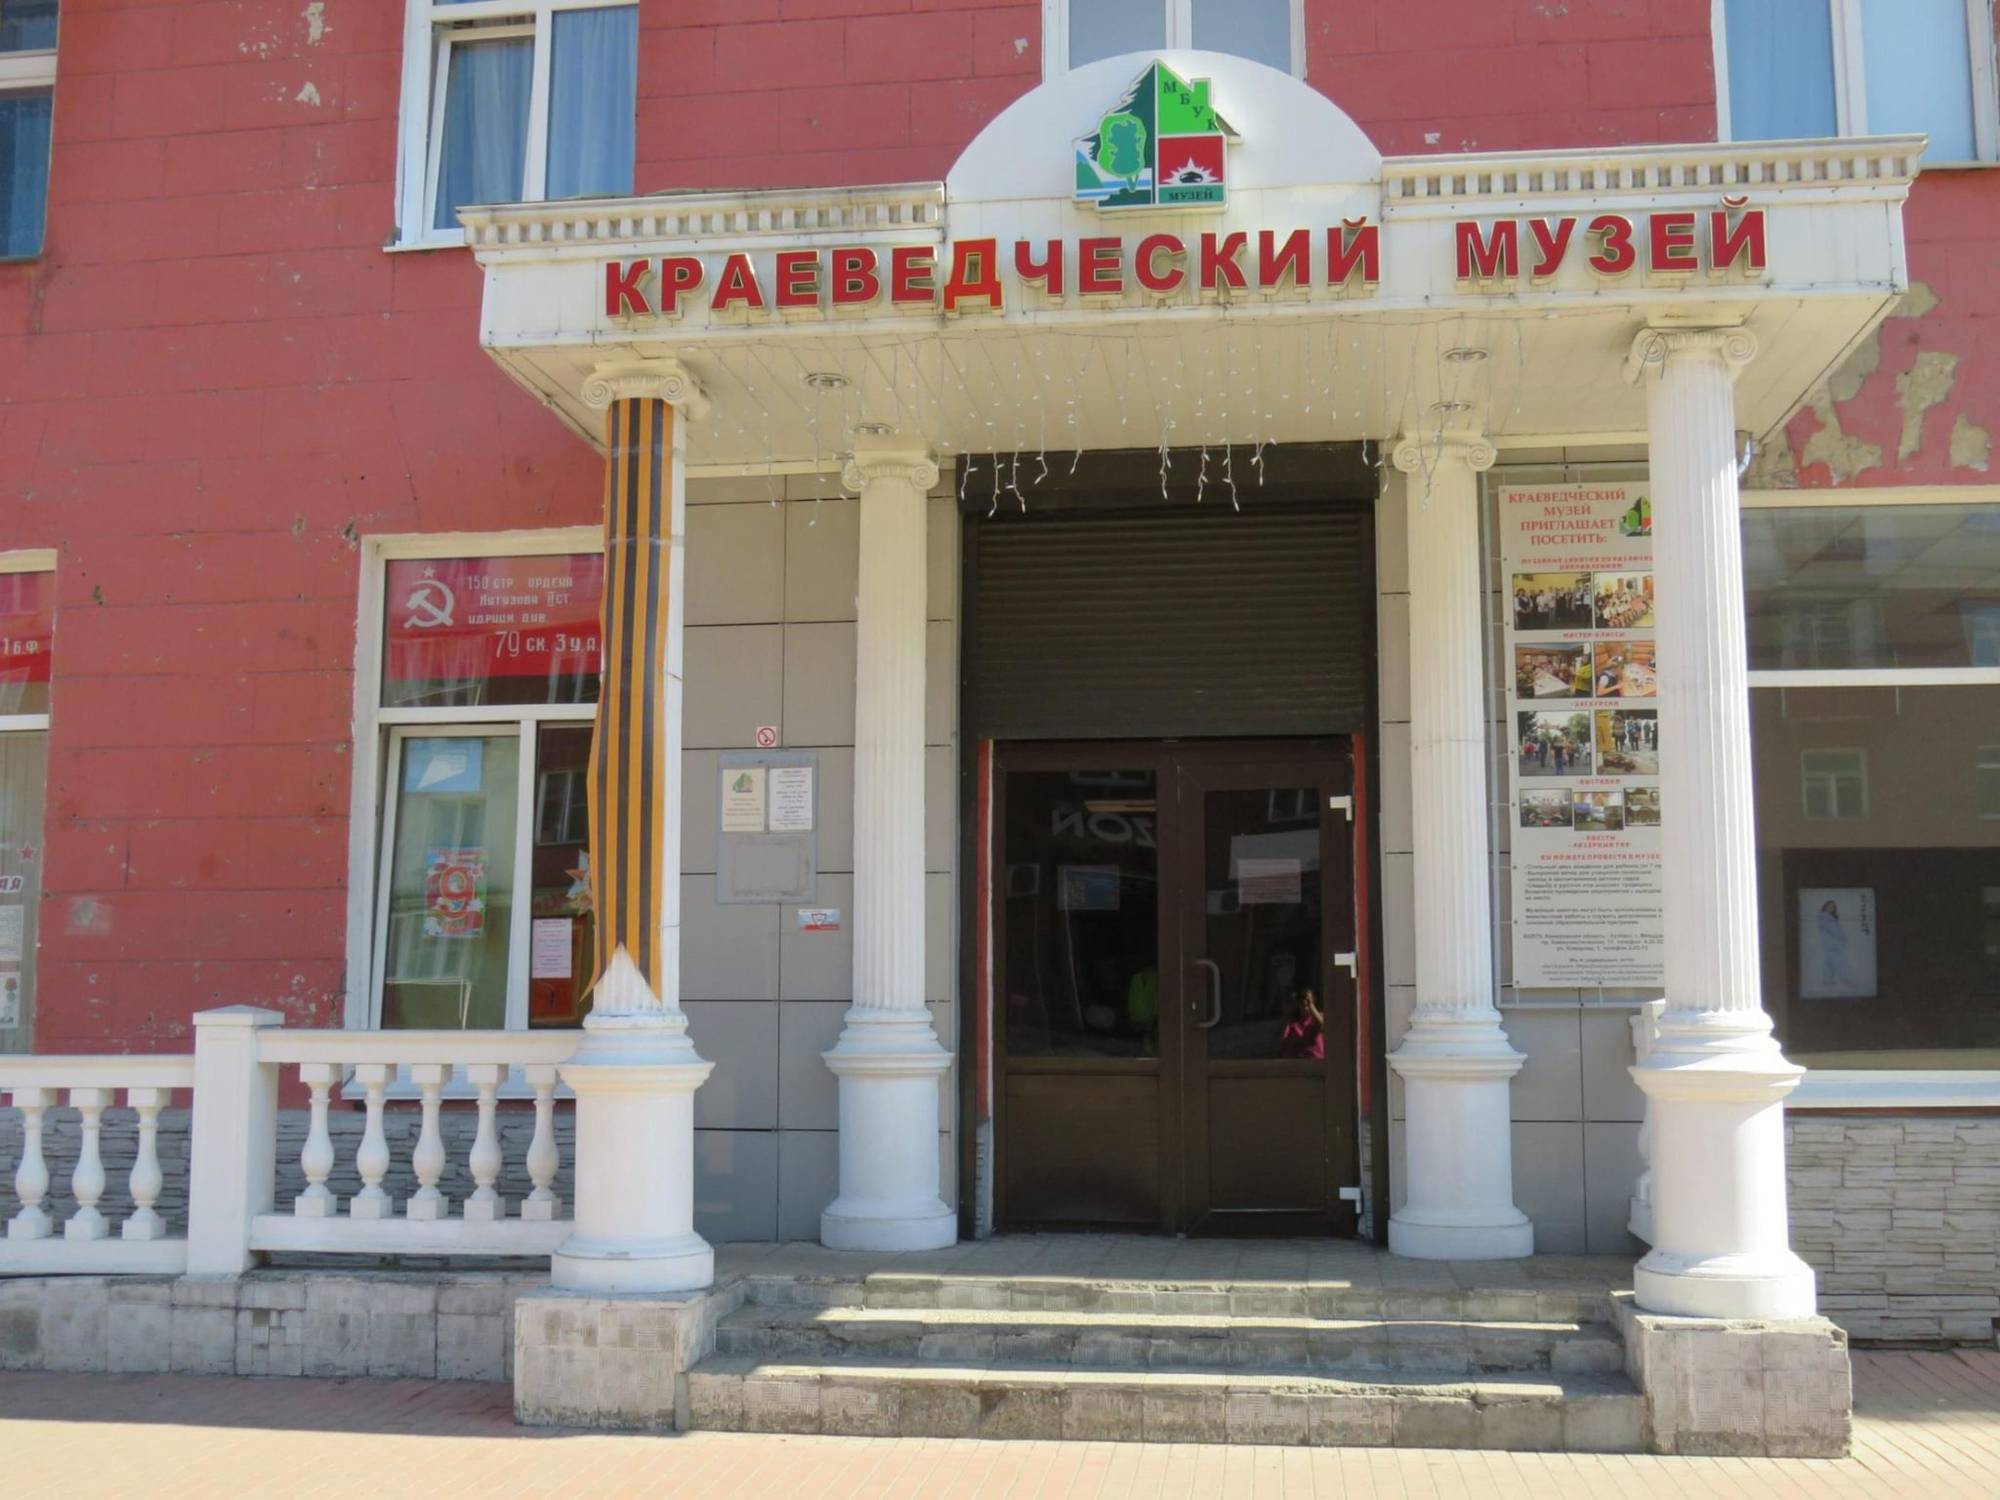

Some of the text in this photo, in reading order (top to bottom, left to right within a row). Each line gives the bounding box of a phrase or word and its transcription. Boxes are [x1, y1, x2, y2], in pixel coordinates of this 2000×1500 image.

[1167, 188, 1213, 200] МУЗЕЙ
[605, 194, 1767, 318] КРАЕВЕДЧЕСКИЙ МУЗЕЙ
[1508, 488, 1625, 504] КРАЕВЕДЧЕСКИЙ
[1543, 503, 1591, 518] МУЗЕЙ
[1520, 518, 1616, 531] ПРИГЛАШАЕТ
[1530, 533, 1607, 545] ПОСЕТИТЬ:
[468, 575, 489, 590] 150
[495, 630, 521, 658] 79
